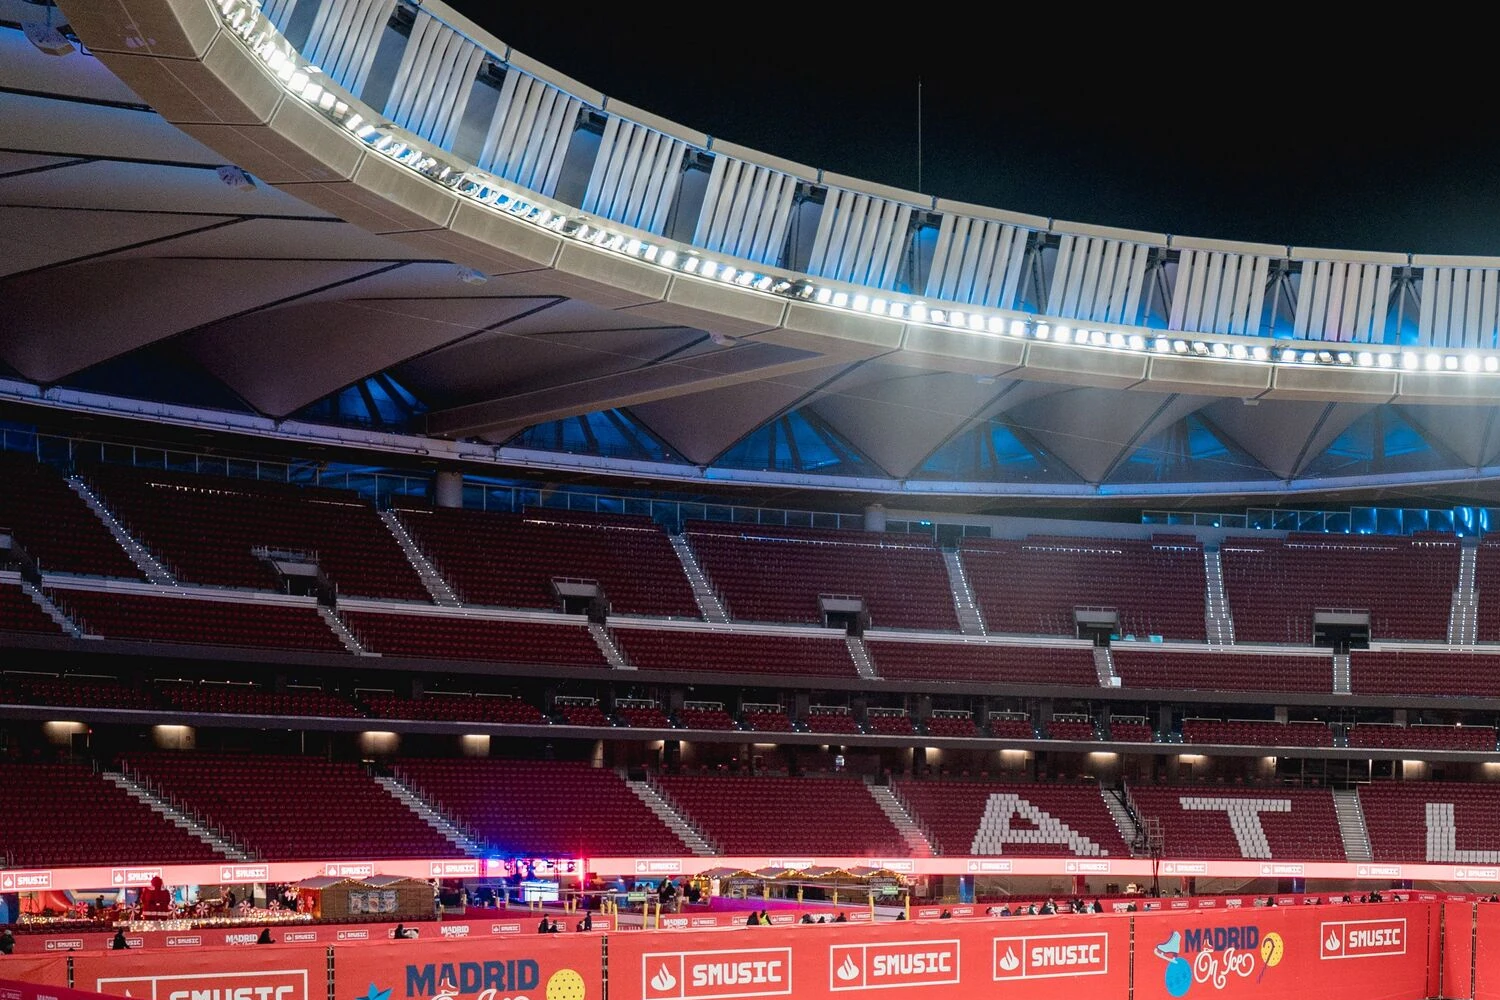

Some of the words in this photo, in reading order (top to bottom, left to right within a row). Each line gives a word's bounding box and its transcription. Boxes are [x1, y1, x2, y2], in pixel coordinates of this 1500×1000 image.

[235, 867, 265, 878] SMUSIC
[340, 865, 371, 875] SMUSIC
[444, 863, 476, 873] SMUSIC
[17, 875, 49, 886] SMUSIC
[225, 933, 258, 943] MADRID
[1184, 925, 1259, 953] MADRID
[1348, 928, 1401, 947] SMUSIC
[873, 951, 951, 976] SMUSIC
[1031, 944, 1100, 967] SMUSIC
[693, 961, 782, 987] SMUSIC
[1193, 951, 1227, 989] On
[1222, 946, 1255, 978] Ice
[405, 959, 540, 998] MADRID
